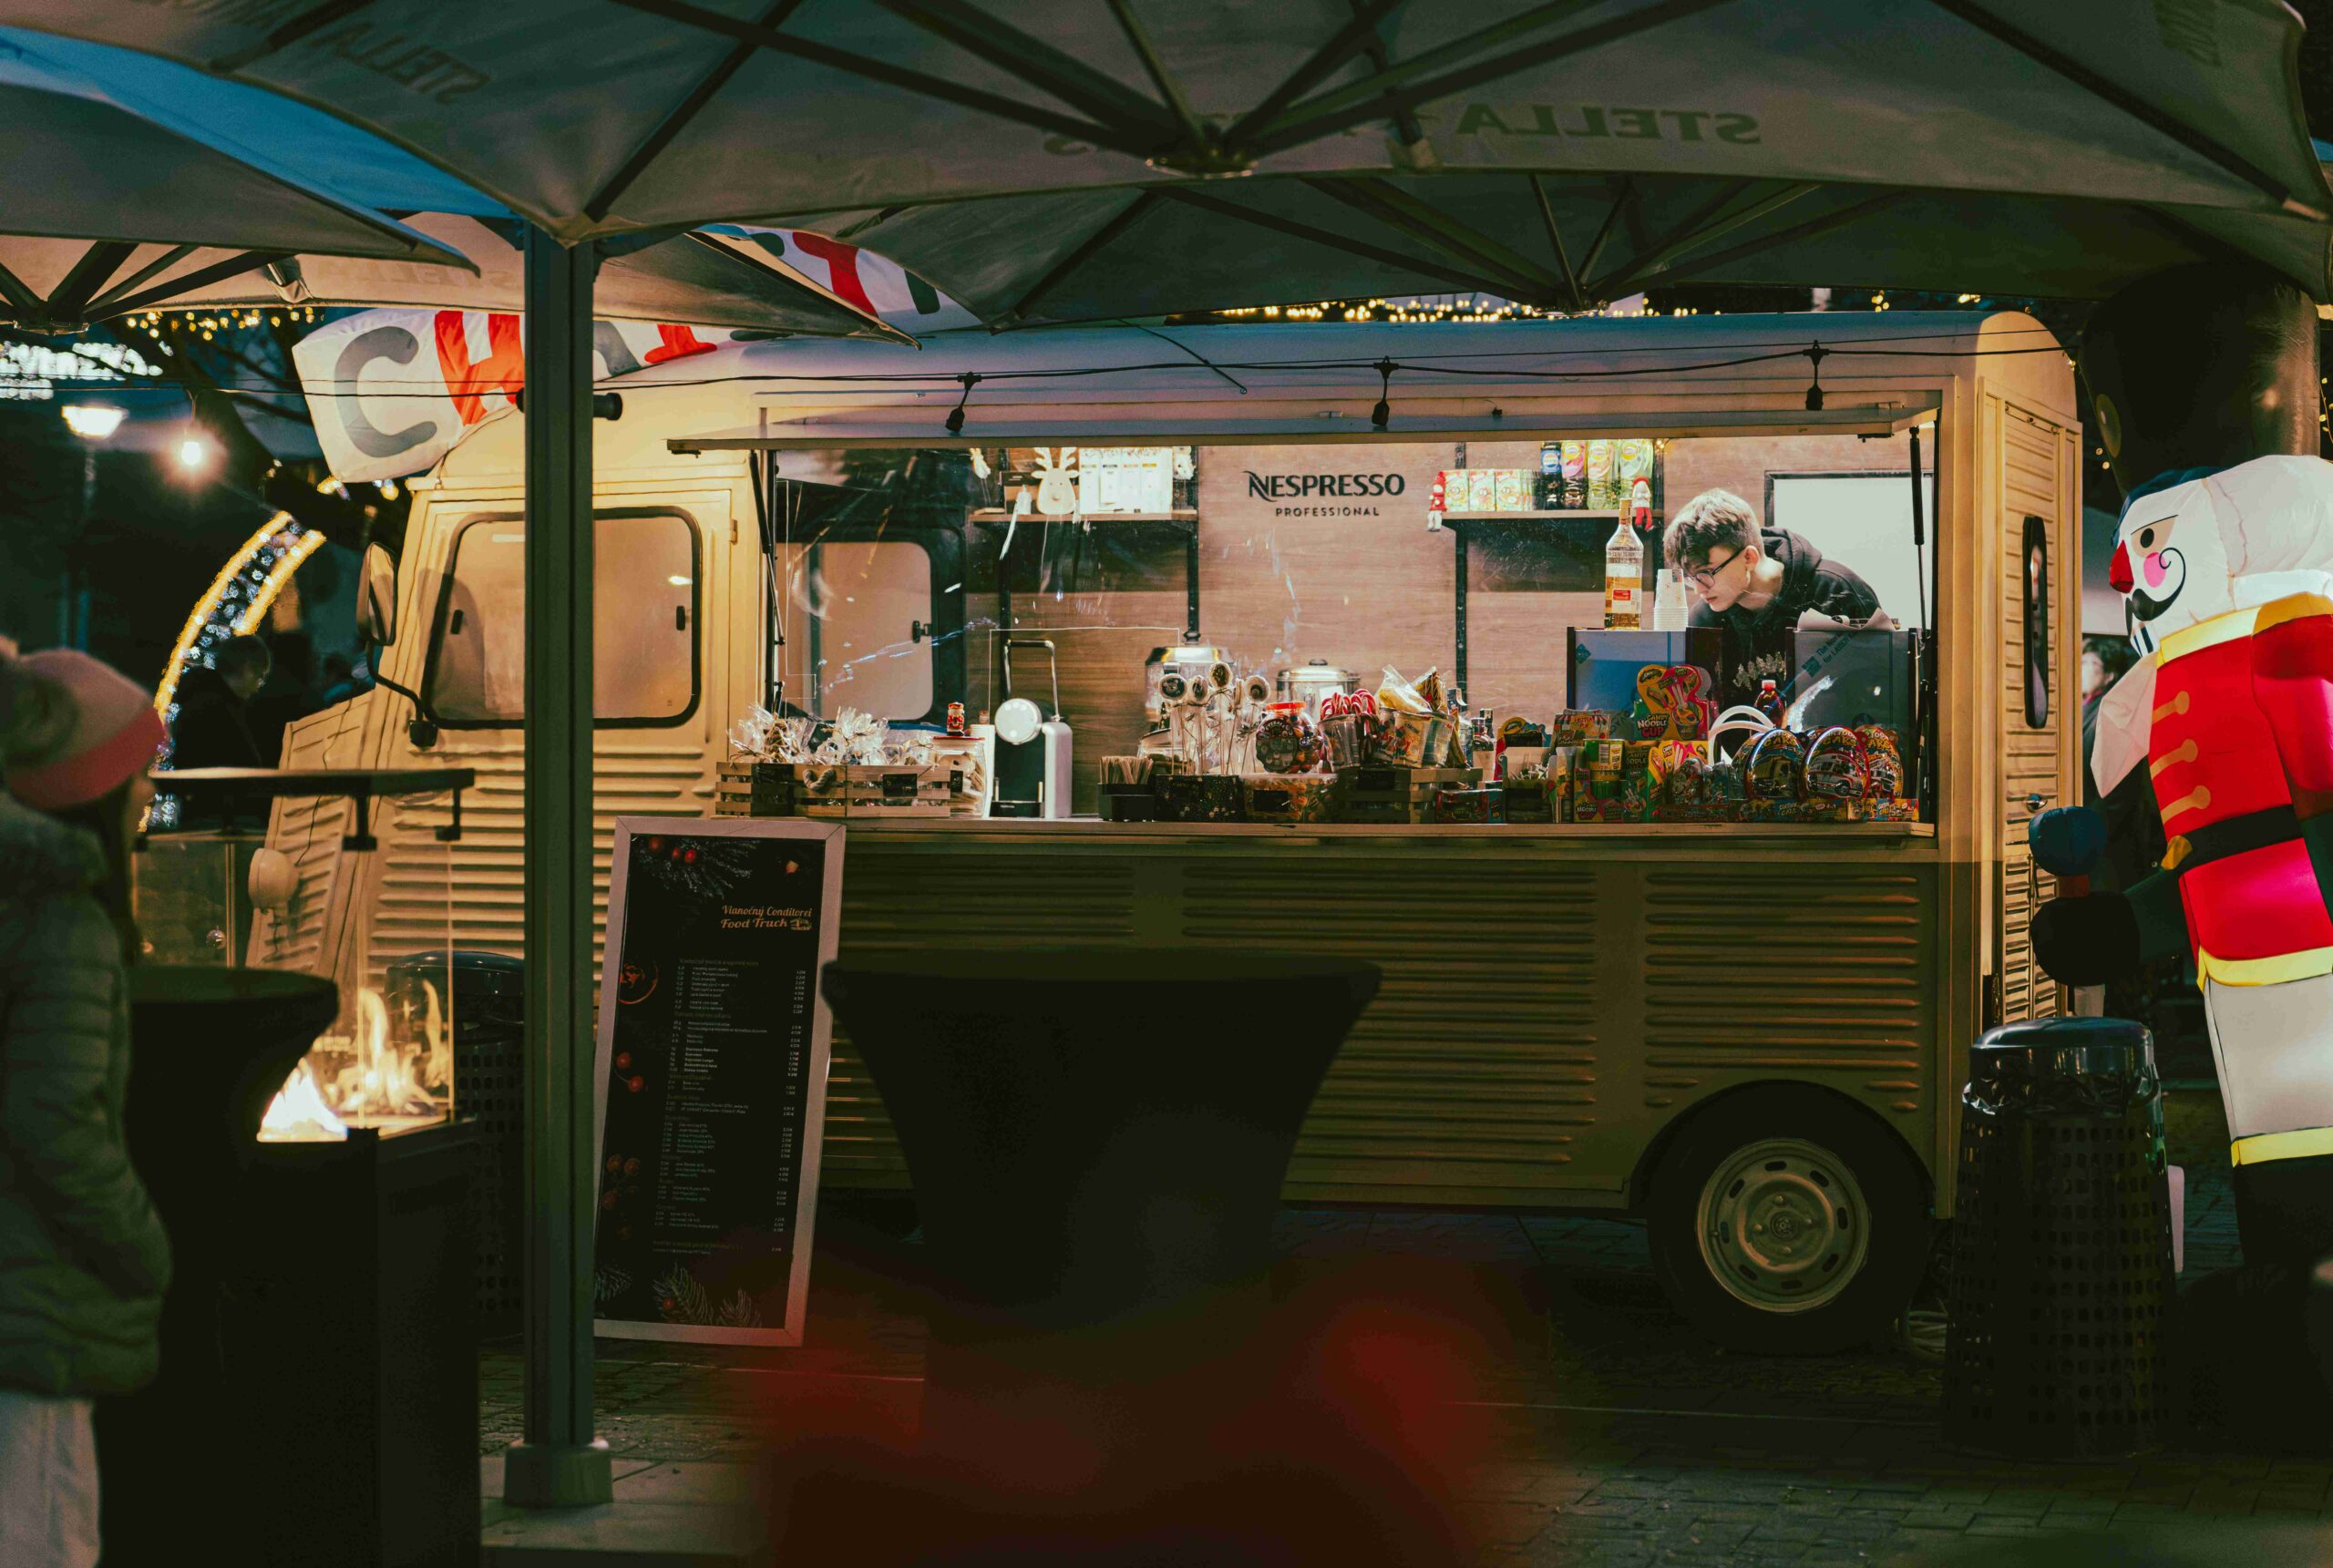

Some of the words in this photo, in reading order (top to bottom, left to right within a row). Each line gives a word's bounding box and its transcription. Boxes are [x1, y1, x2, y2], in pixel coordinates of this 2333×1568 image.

[1241, 471, 1405, 502] NESPRESSO
[1276, 507, 1380, 517] PROFESSIONAL
[1637, 720, 1668, 729] NOODLE
[1641, 728, 1664, 737] CUP
[720, 918, 751, 928] Food
[753, 917, 787, 927] Truck
